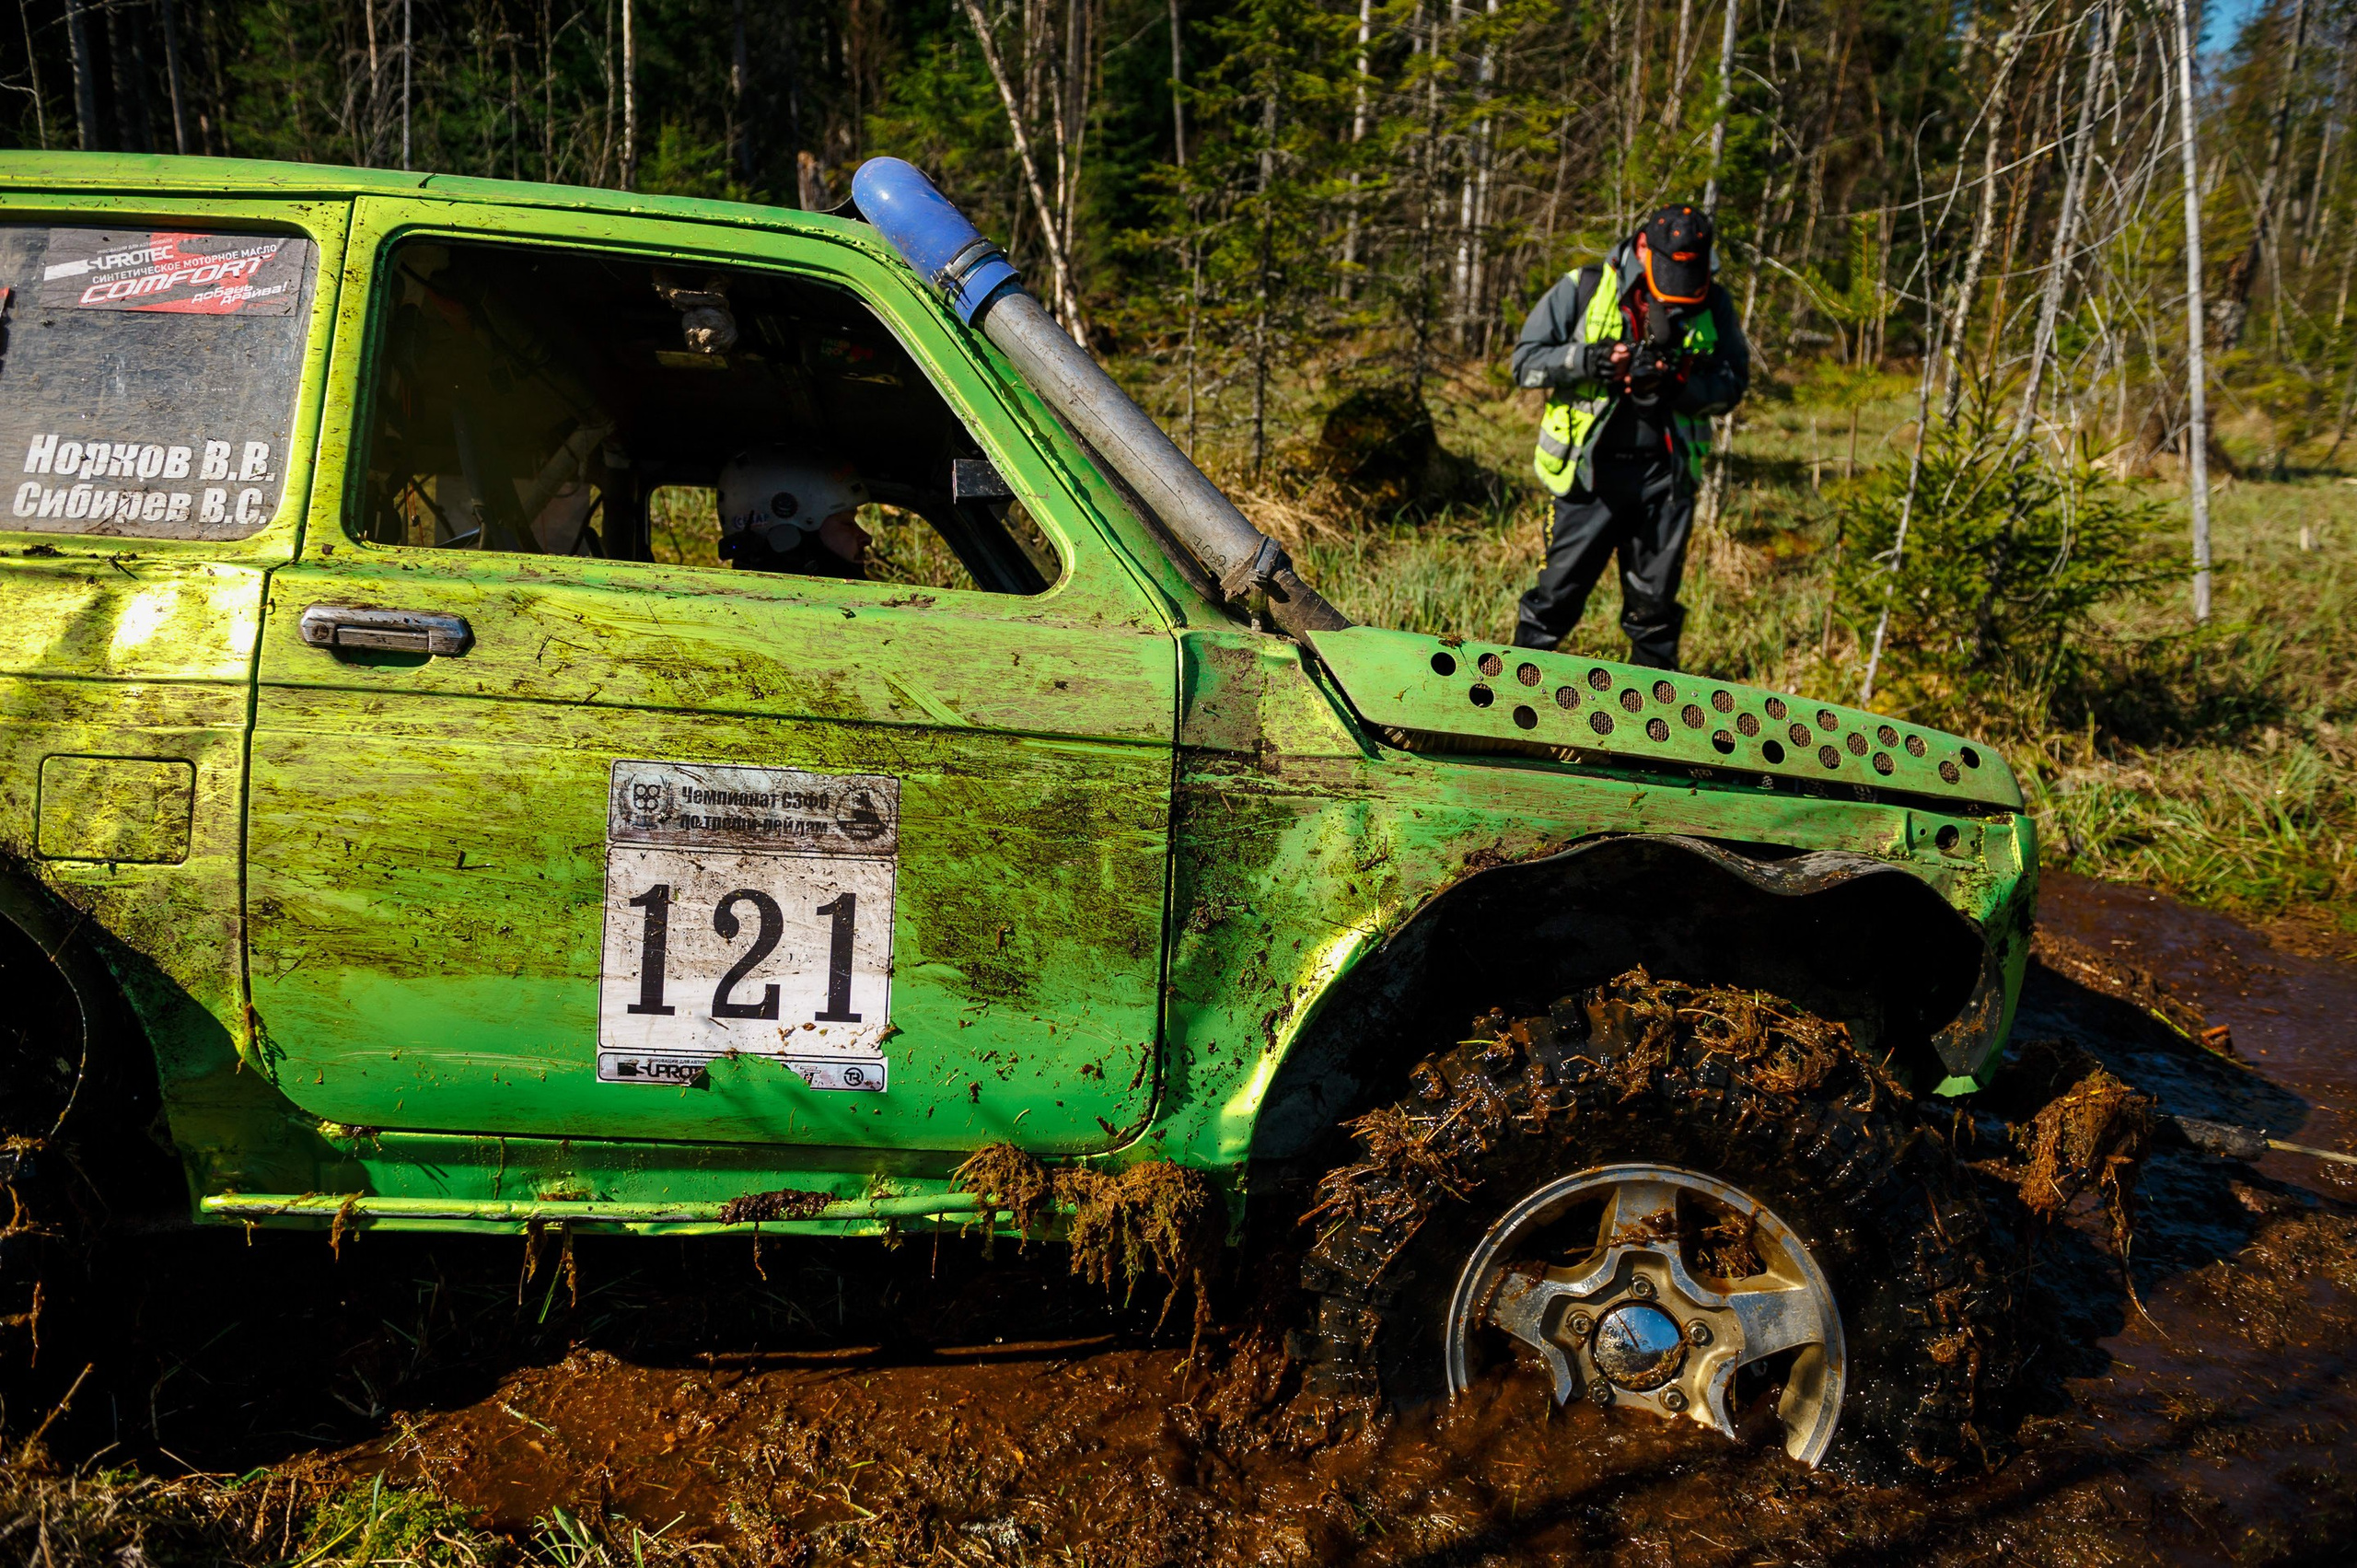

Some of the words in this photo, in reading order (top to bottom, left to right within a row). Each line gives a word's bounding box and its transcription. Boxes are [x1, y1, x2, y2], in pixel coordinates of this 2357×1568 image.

[80, 253, 273, 304] COMFORT
[87, 245, 174, 271] SUPROTEC
[92, 261, 181, 285] СИНТЕТИЧЕСКОЕ
[182, 250, 239, 268] МОТОРНОЕ
[240, 244, 277, 258] МАСЛО
[220, 281, 288, 306] драйва!
[23, 435, 193, 480] Норков
[199, 439, 276, 482] В.В.
[12, 482, 192, 524] Сибирев
[198, 487, 268, 525] В.С.
[681, 785, 779, 808] Чемпионат
[679, 814, 700, 830] по
[702, 815, 829, 836] трофи-рейдам
[626, 884, 862, 1024] 121
